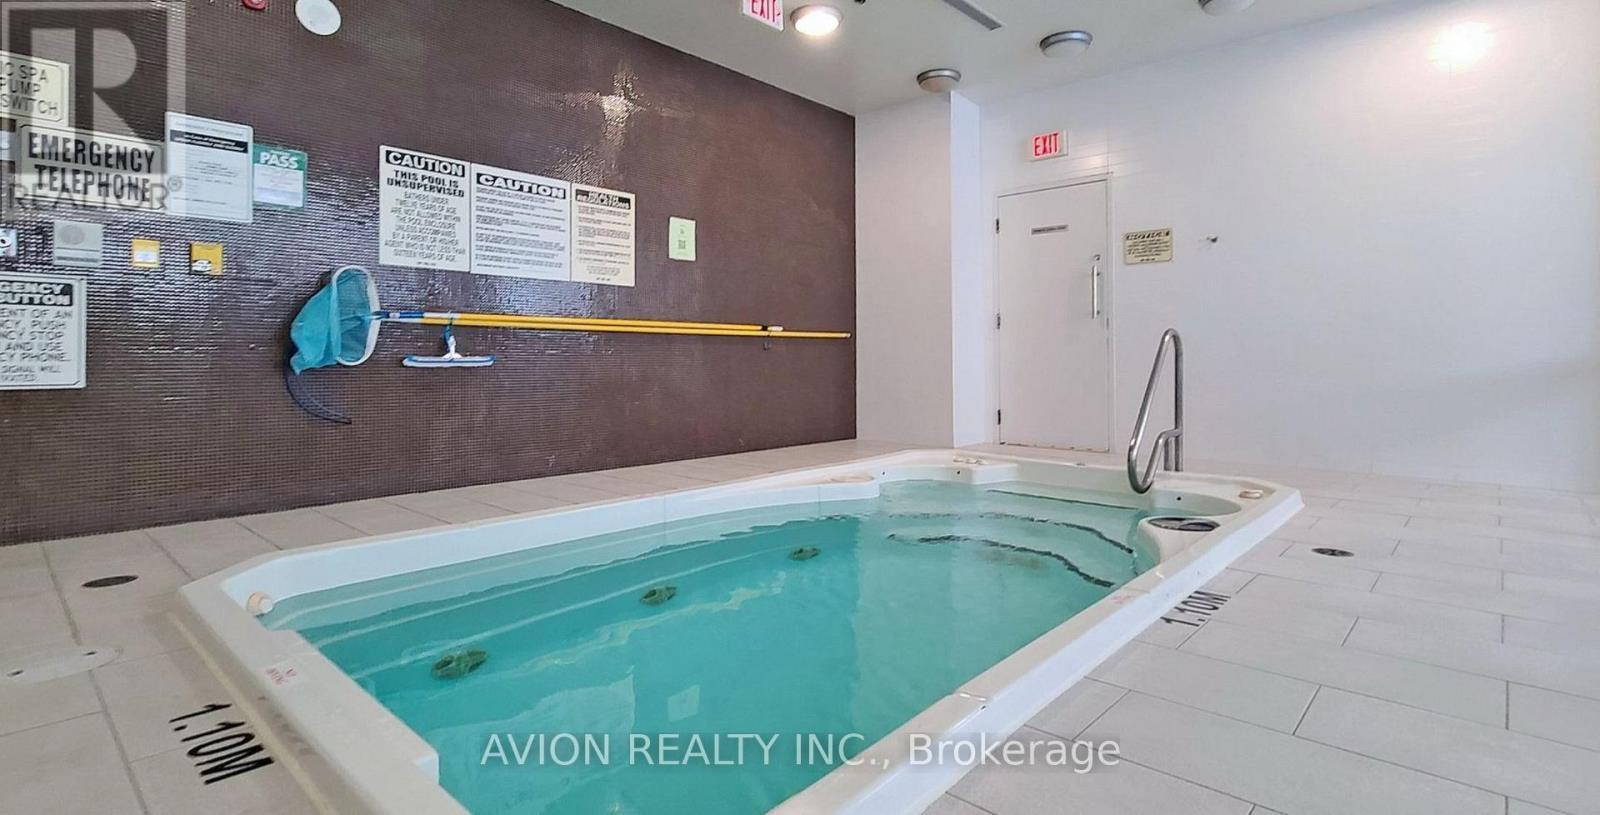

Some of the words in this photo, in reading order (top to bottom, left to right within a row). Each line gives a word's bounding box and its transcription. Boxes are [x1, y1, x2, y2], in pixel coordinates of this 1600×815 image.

[19, 65, 48, 83] SPA
[1, 94, 58, 116] SWITCH
[28, 132, 155, 173] EMERGENCY
[1034, 133, 1059, 156] EXIT
[260, 151, 299, 169] PASS
[388, 151, 464, 177] CAUTION
[34, 164, 152, 202] TELEPHONE
[387, 178, 464, 198] UNSUPERVISED
[394, 169, 418, 181] THIS
[421, 174, 447, 187] POOL
[449, 179, 459, 188] IS
[479, 174, 565, 198] CAUTION
[32, 308, 50, 319] OF
[54, 310, 72, 320] AN
[32, 319, 65, 331] PUSH
[30, 331, 64, 341] STOP
[6, 342, 33, 352] AND
[40, 342, 63, 352] USE
[1159, 590, 1231, 627] 1.10M
[168, 703, 275, 785] 1.10M
